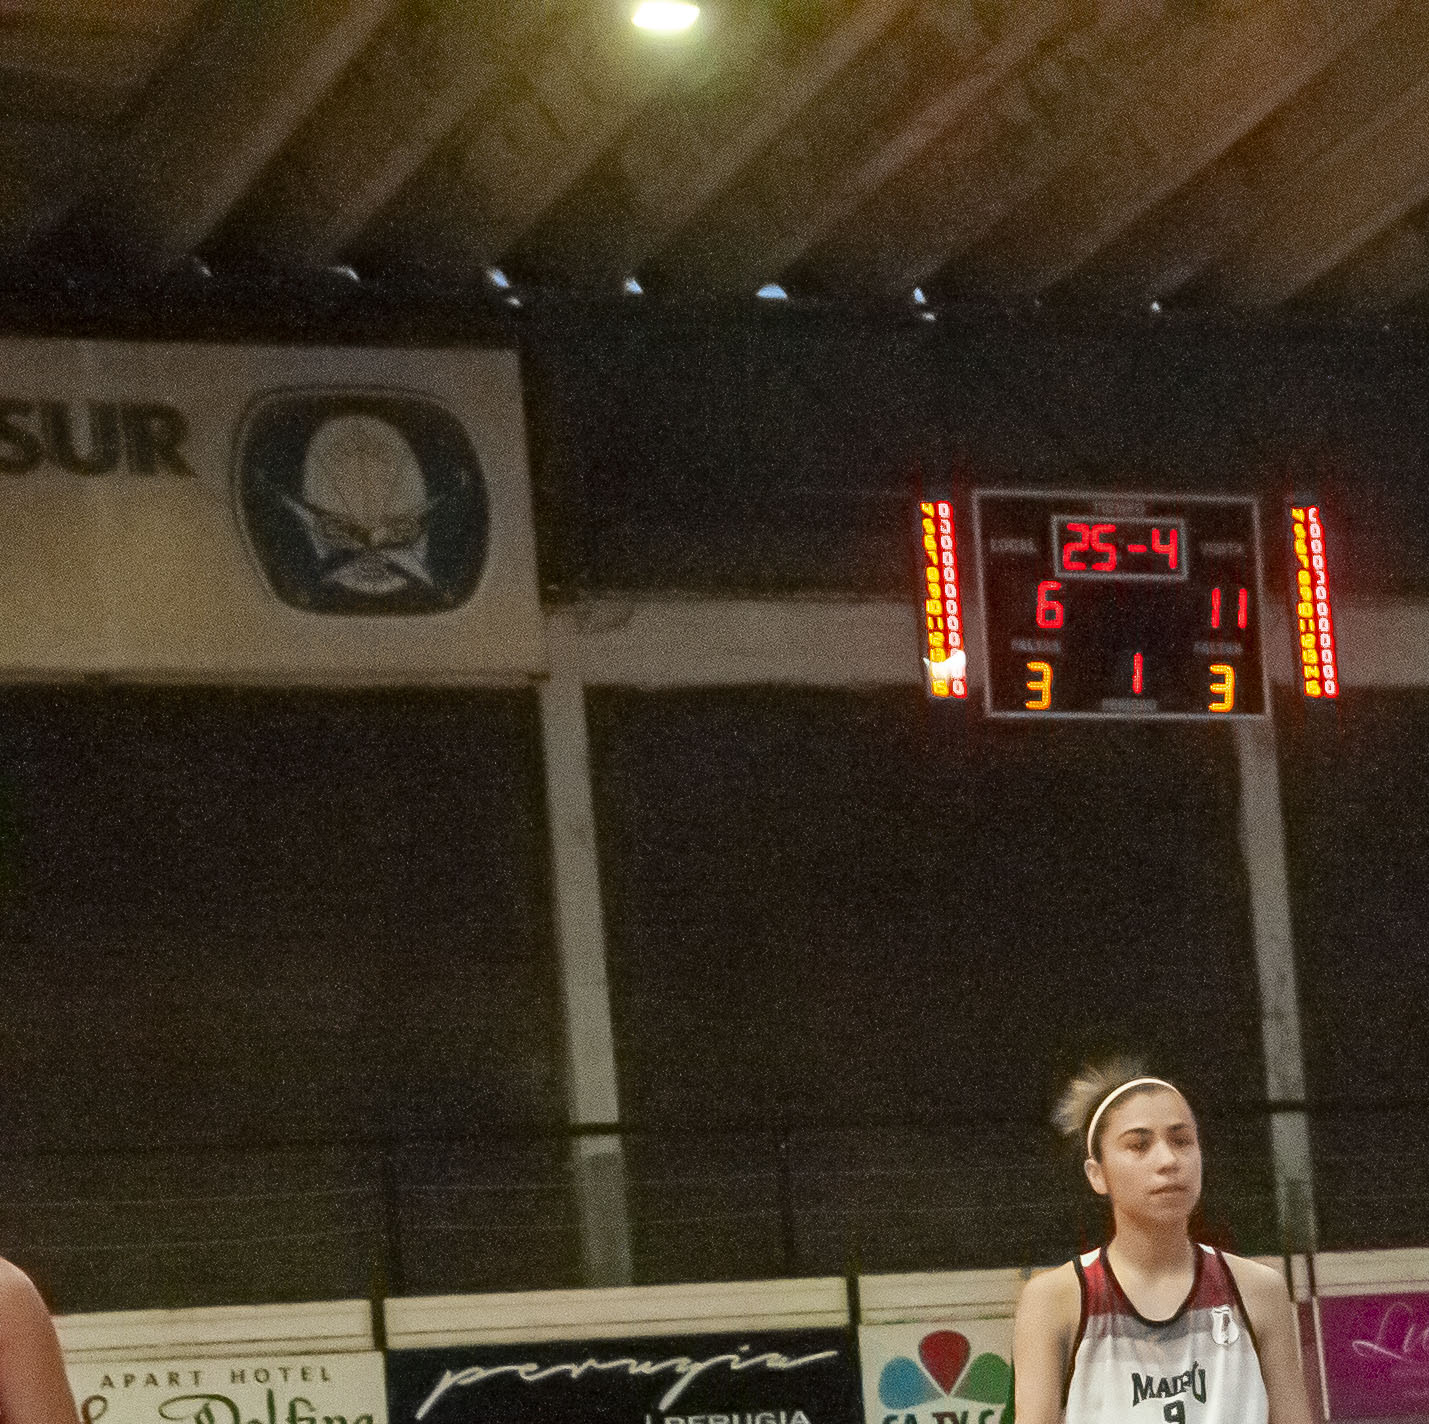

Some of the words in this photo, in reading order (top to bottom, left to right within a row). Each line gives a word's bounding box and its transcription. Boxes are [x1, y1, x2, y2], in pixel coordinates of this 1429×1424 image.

[1036, 581, 1063, 628] 6
[1211, 588, 1247, 628] 11
[1026, 661, 1054, 710] 3
[1208, 664, 1235, 712] 3
[101, 1369, 202, 1390] APART
[231, 1365, 332, 1385] HOTEL
